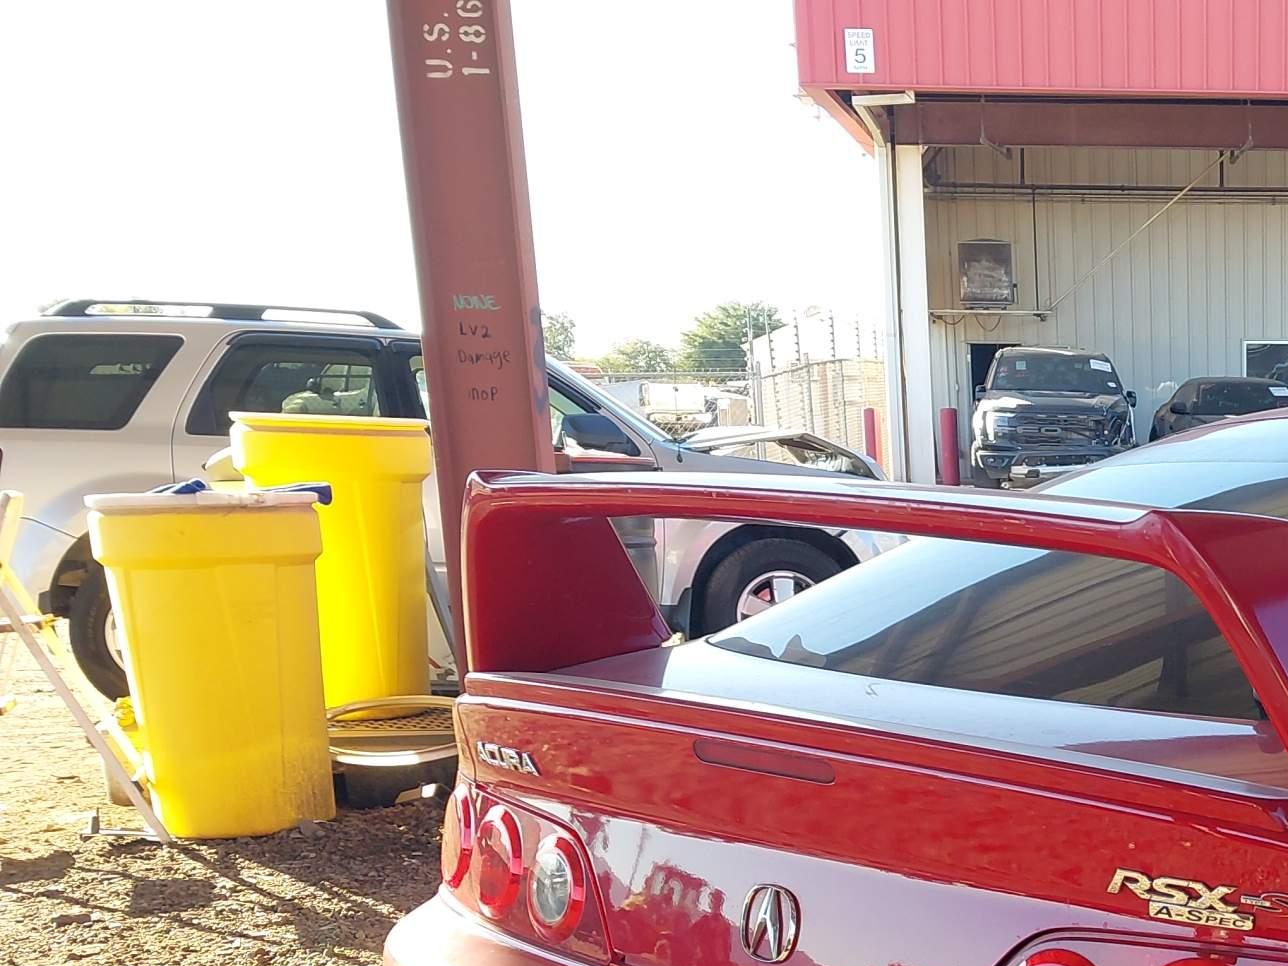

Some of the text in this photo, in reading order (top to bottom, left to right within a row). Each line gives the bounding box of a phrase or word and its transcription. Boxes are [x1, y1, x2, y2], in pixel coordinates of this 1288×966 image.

[423, 13, 453, 78] U.S.
[847, 31, 871, 39] SPEED
[854, 48, 866, 64] 5
[477, 741, 540, 776] ACURA
[1107, 868, 1237, 912] RSX
[1153, 905, 1246, 929] A-SPEC
